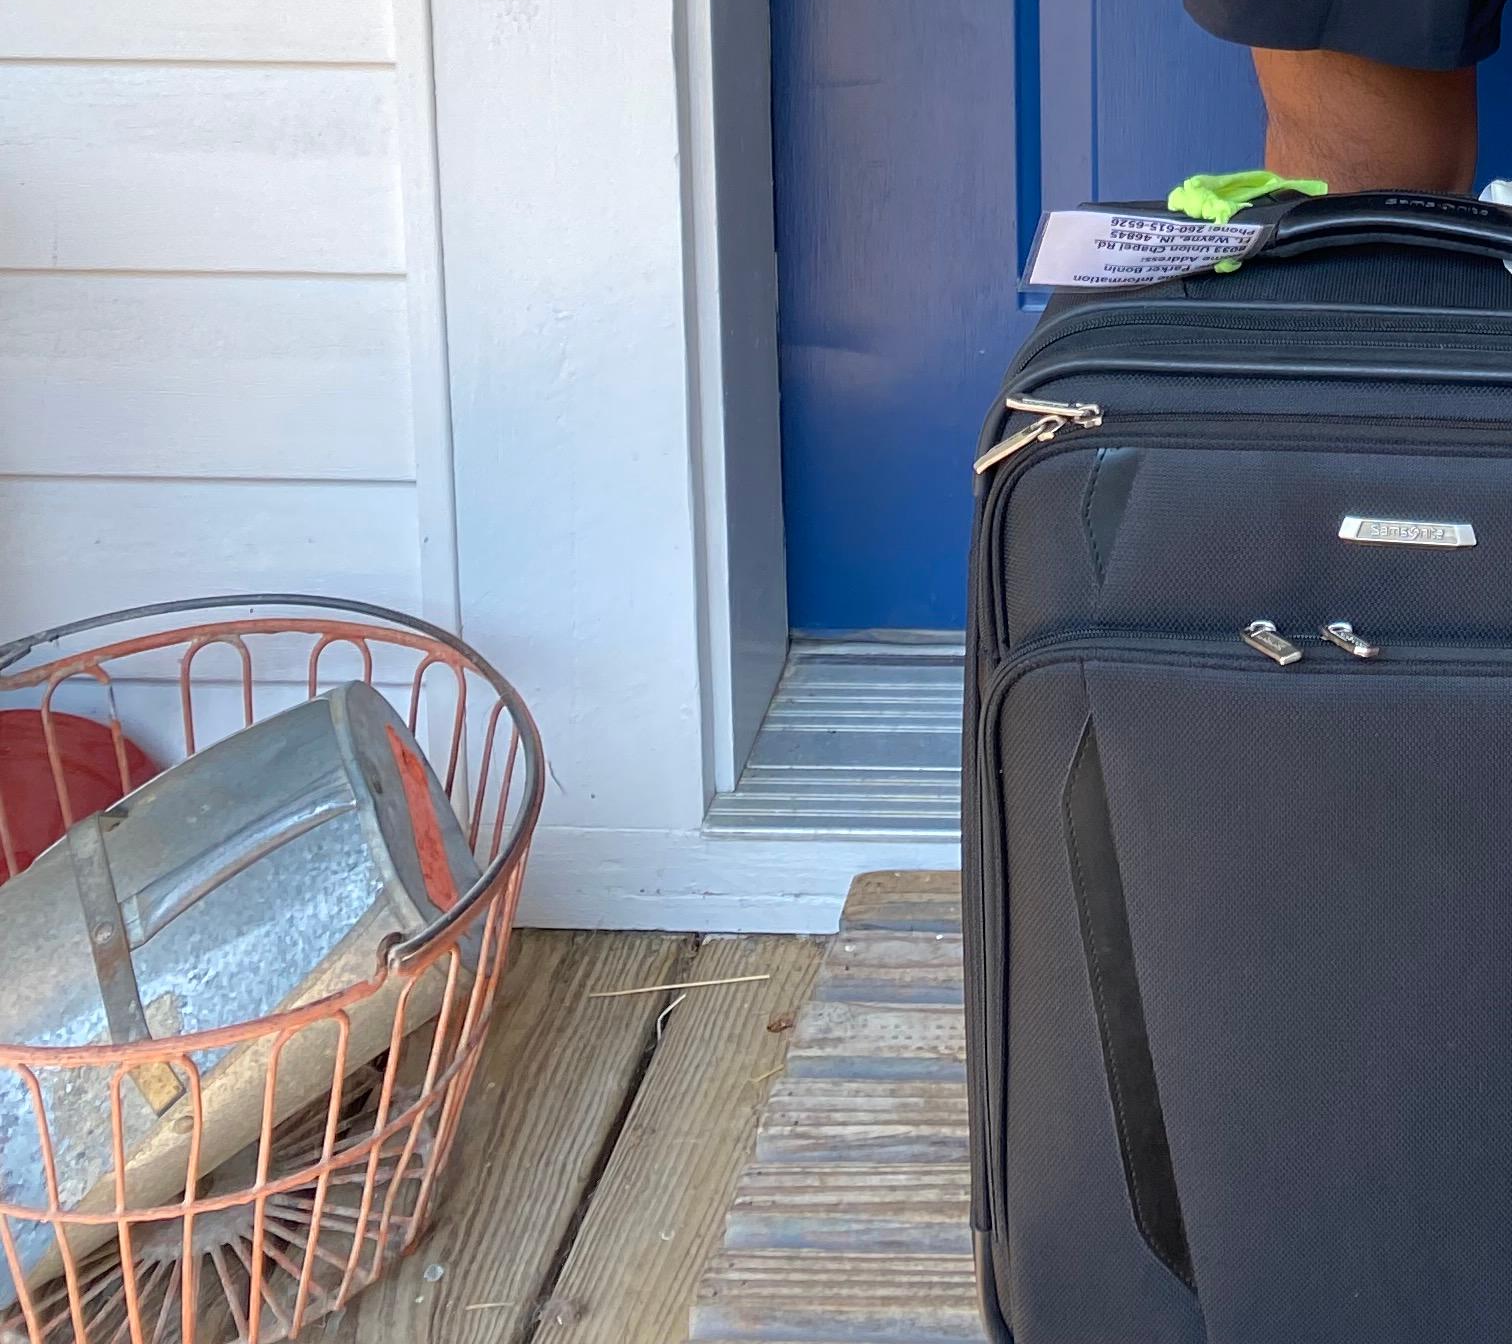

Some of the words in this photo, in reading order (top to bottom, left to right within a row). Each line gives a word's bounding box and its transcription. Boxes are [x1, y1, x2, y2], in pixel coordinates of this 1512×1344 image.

[1110, 216, 1206, 234] 260-615-6526
[1118, 242, 1166, 254] Chapel
[1103, 264, 1143, 274] Bonin
[1145, 265, 1191, 273] Parker
[1072, 274, 1154, 284] Information
[1370, 524, 1445, 540] Samsonite
